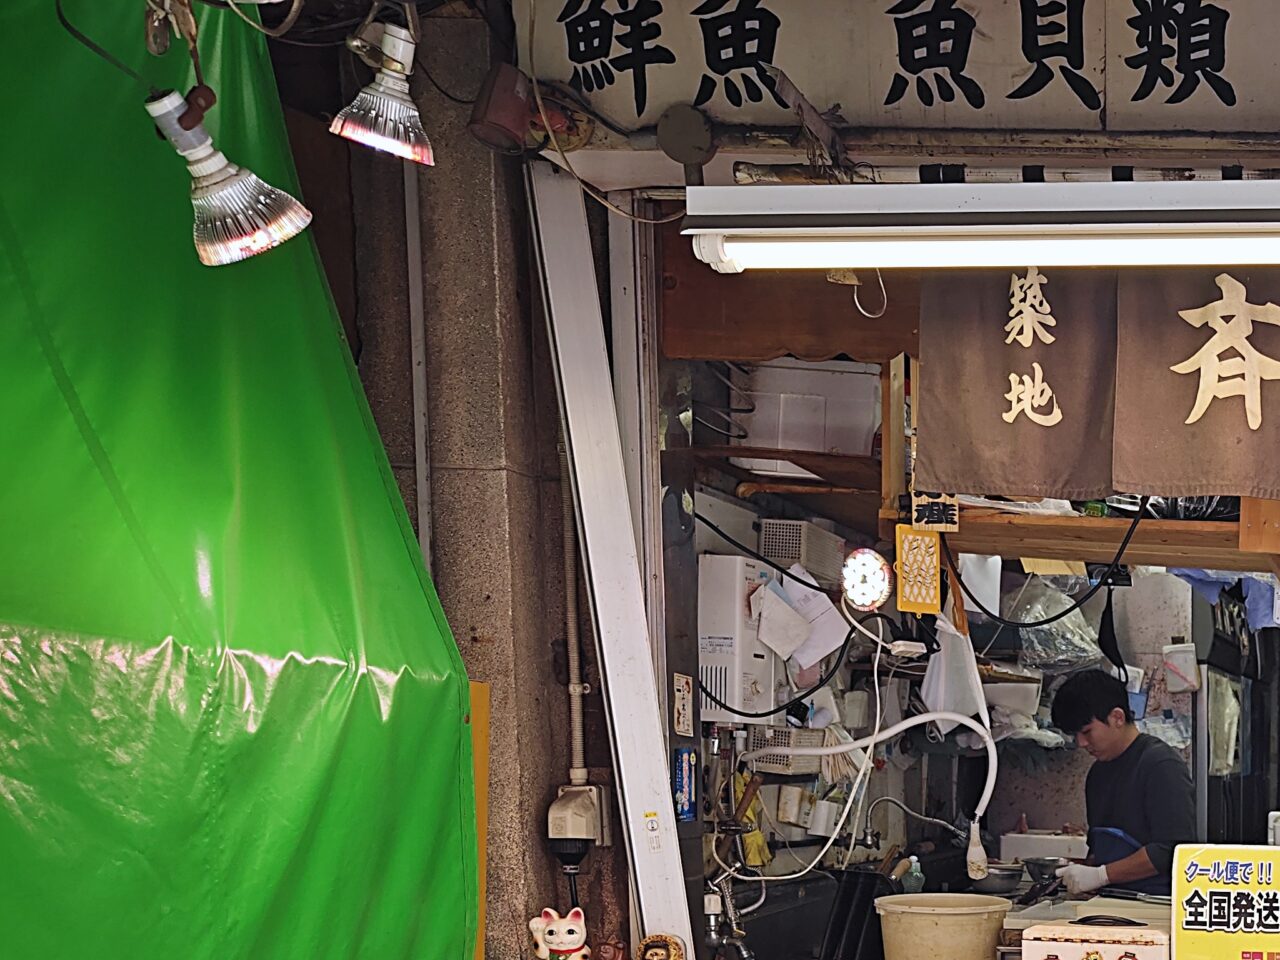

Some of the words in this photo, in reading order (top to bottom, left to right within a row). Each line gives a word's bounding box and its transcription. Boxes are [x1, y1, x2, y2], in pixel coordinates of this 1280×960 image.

[882, 0, 1237, 112] 魚貝類
[1003, 266, 1064, 428] 築地
